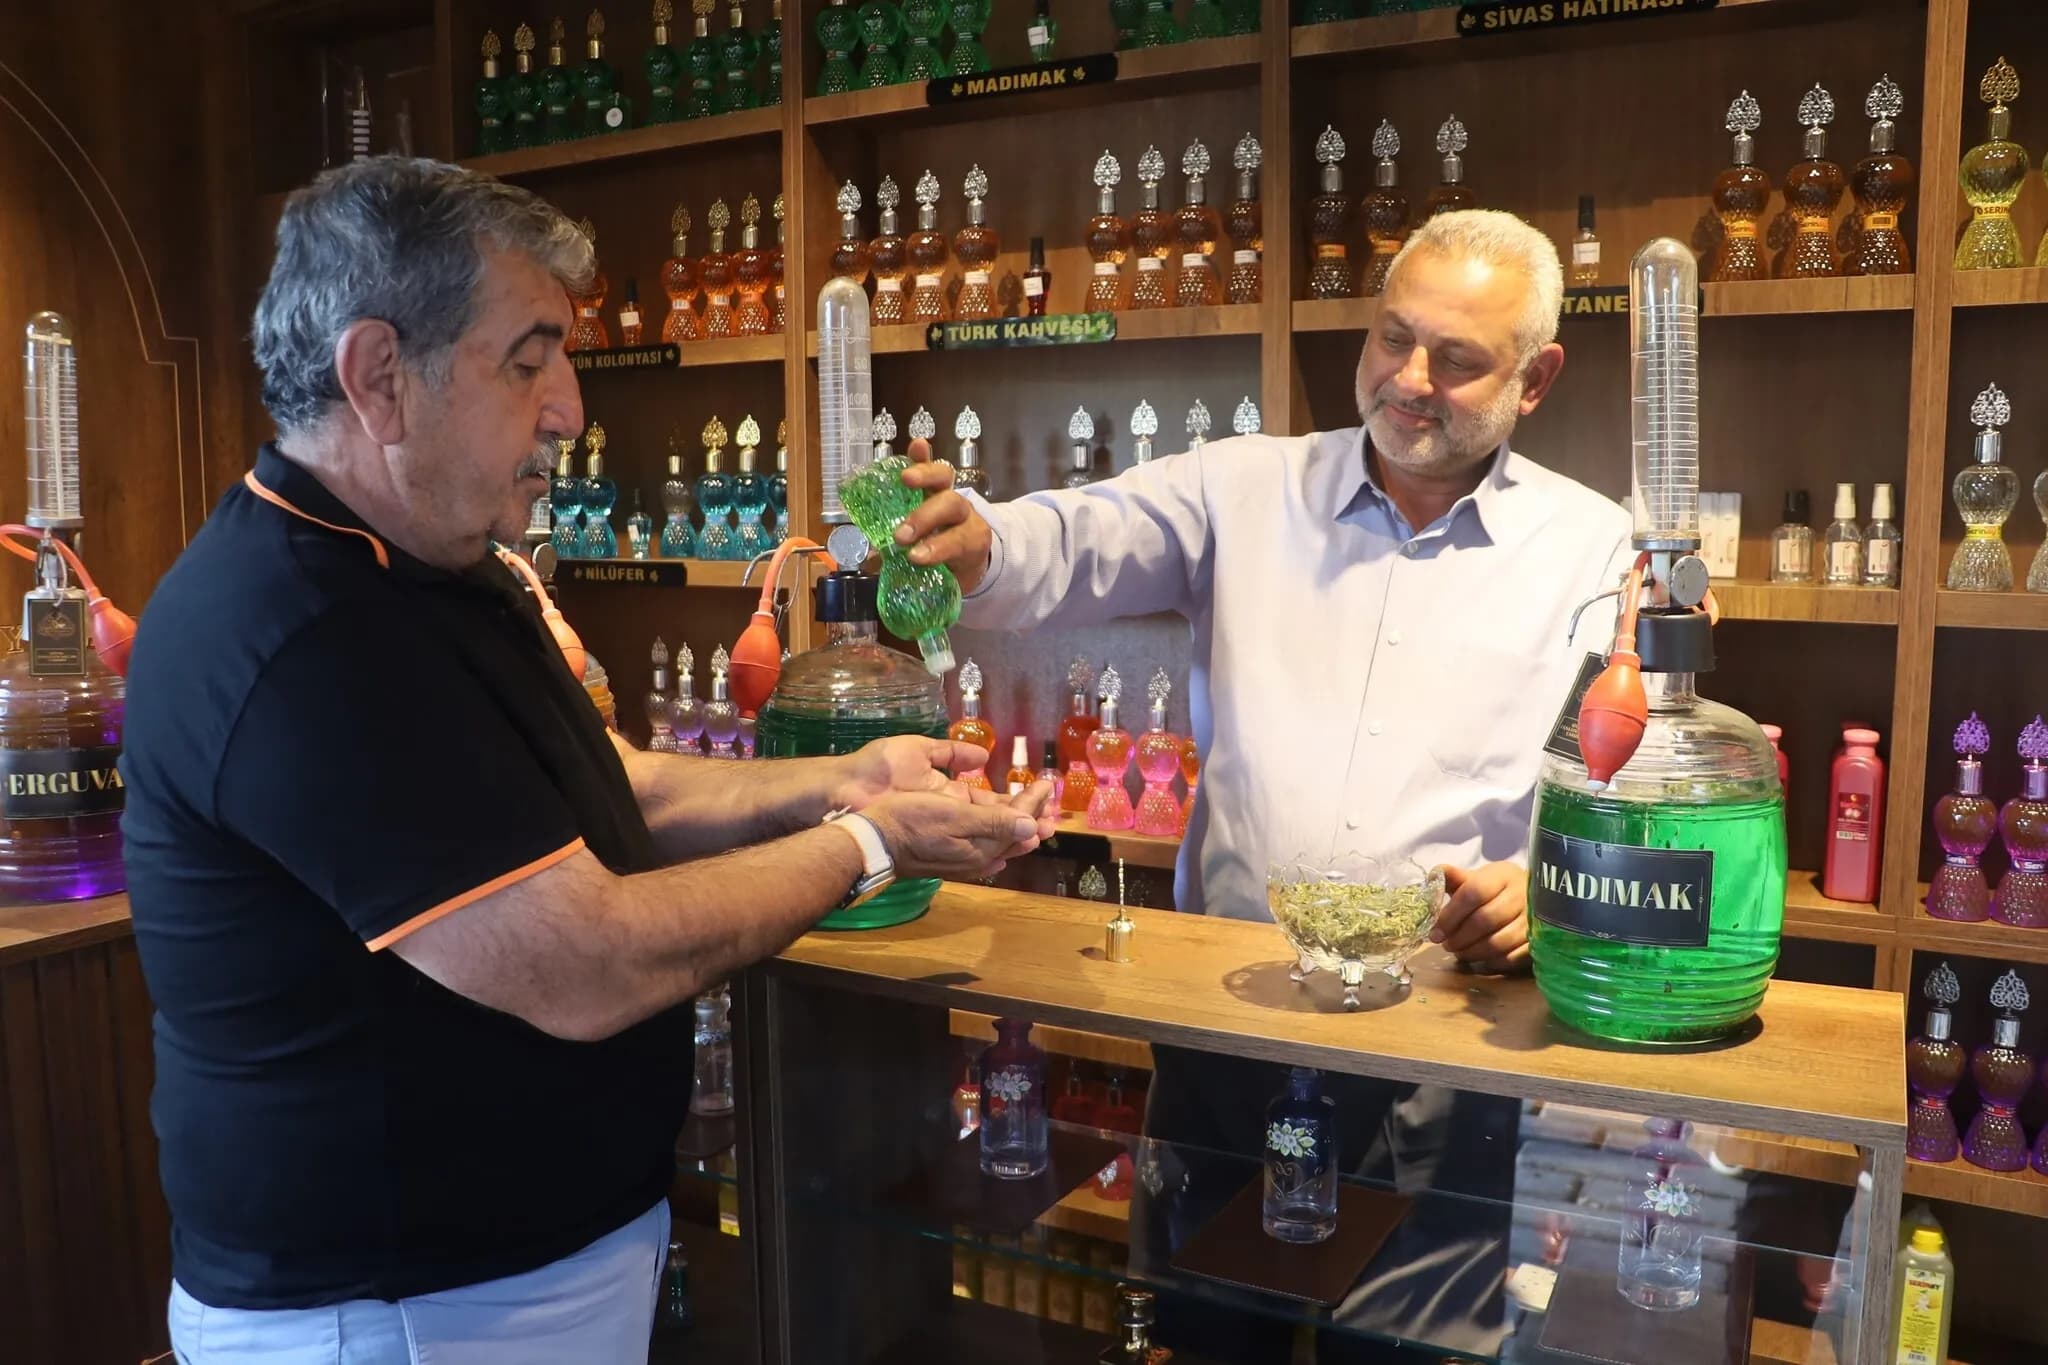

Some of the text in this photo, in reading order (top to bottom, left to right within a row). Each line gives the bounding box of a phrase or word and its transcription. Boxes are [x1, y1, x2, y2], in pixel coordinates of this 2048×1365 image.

[1484, 4, 1554, 29] SİVAS
[967, 68, 1066, 95] MADIMAK
[947, 321, 998, 342] TÜRK
[596, 350, 661, 369] KOLONYASI
[585, 564, 645, 581] NİLÜFER
[1541, 861, 1694, 911] MADIMAK
